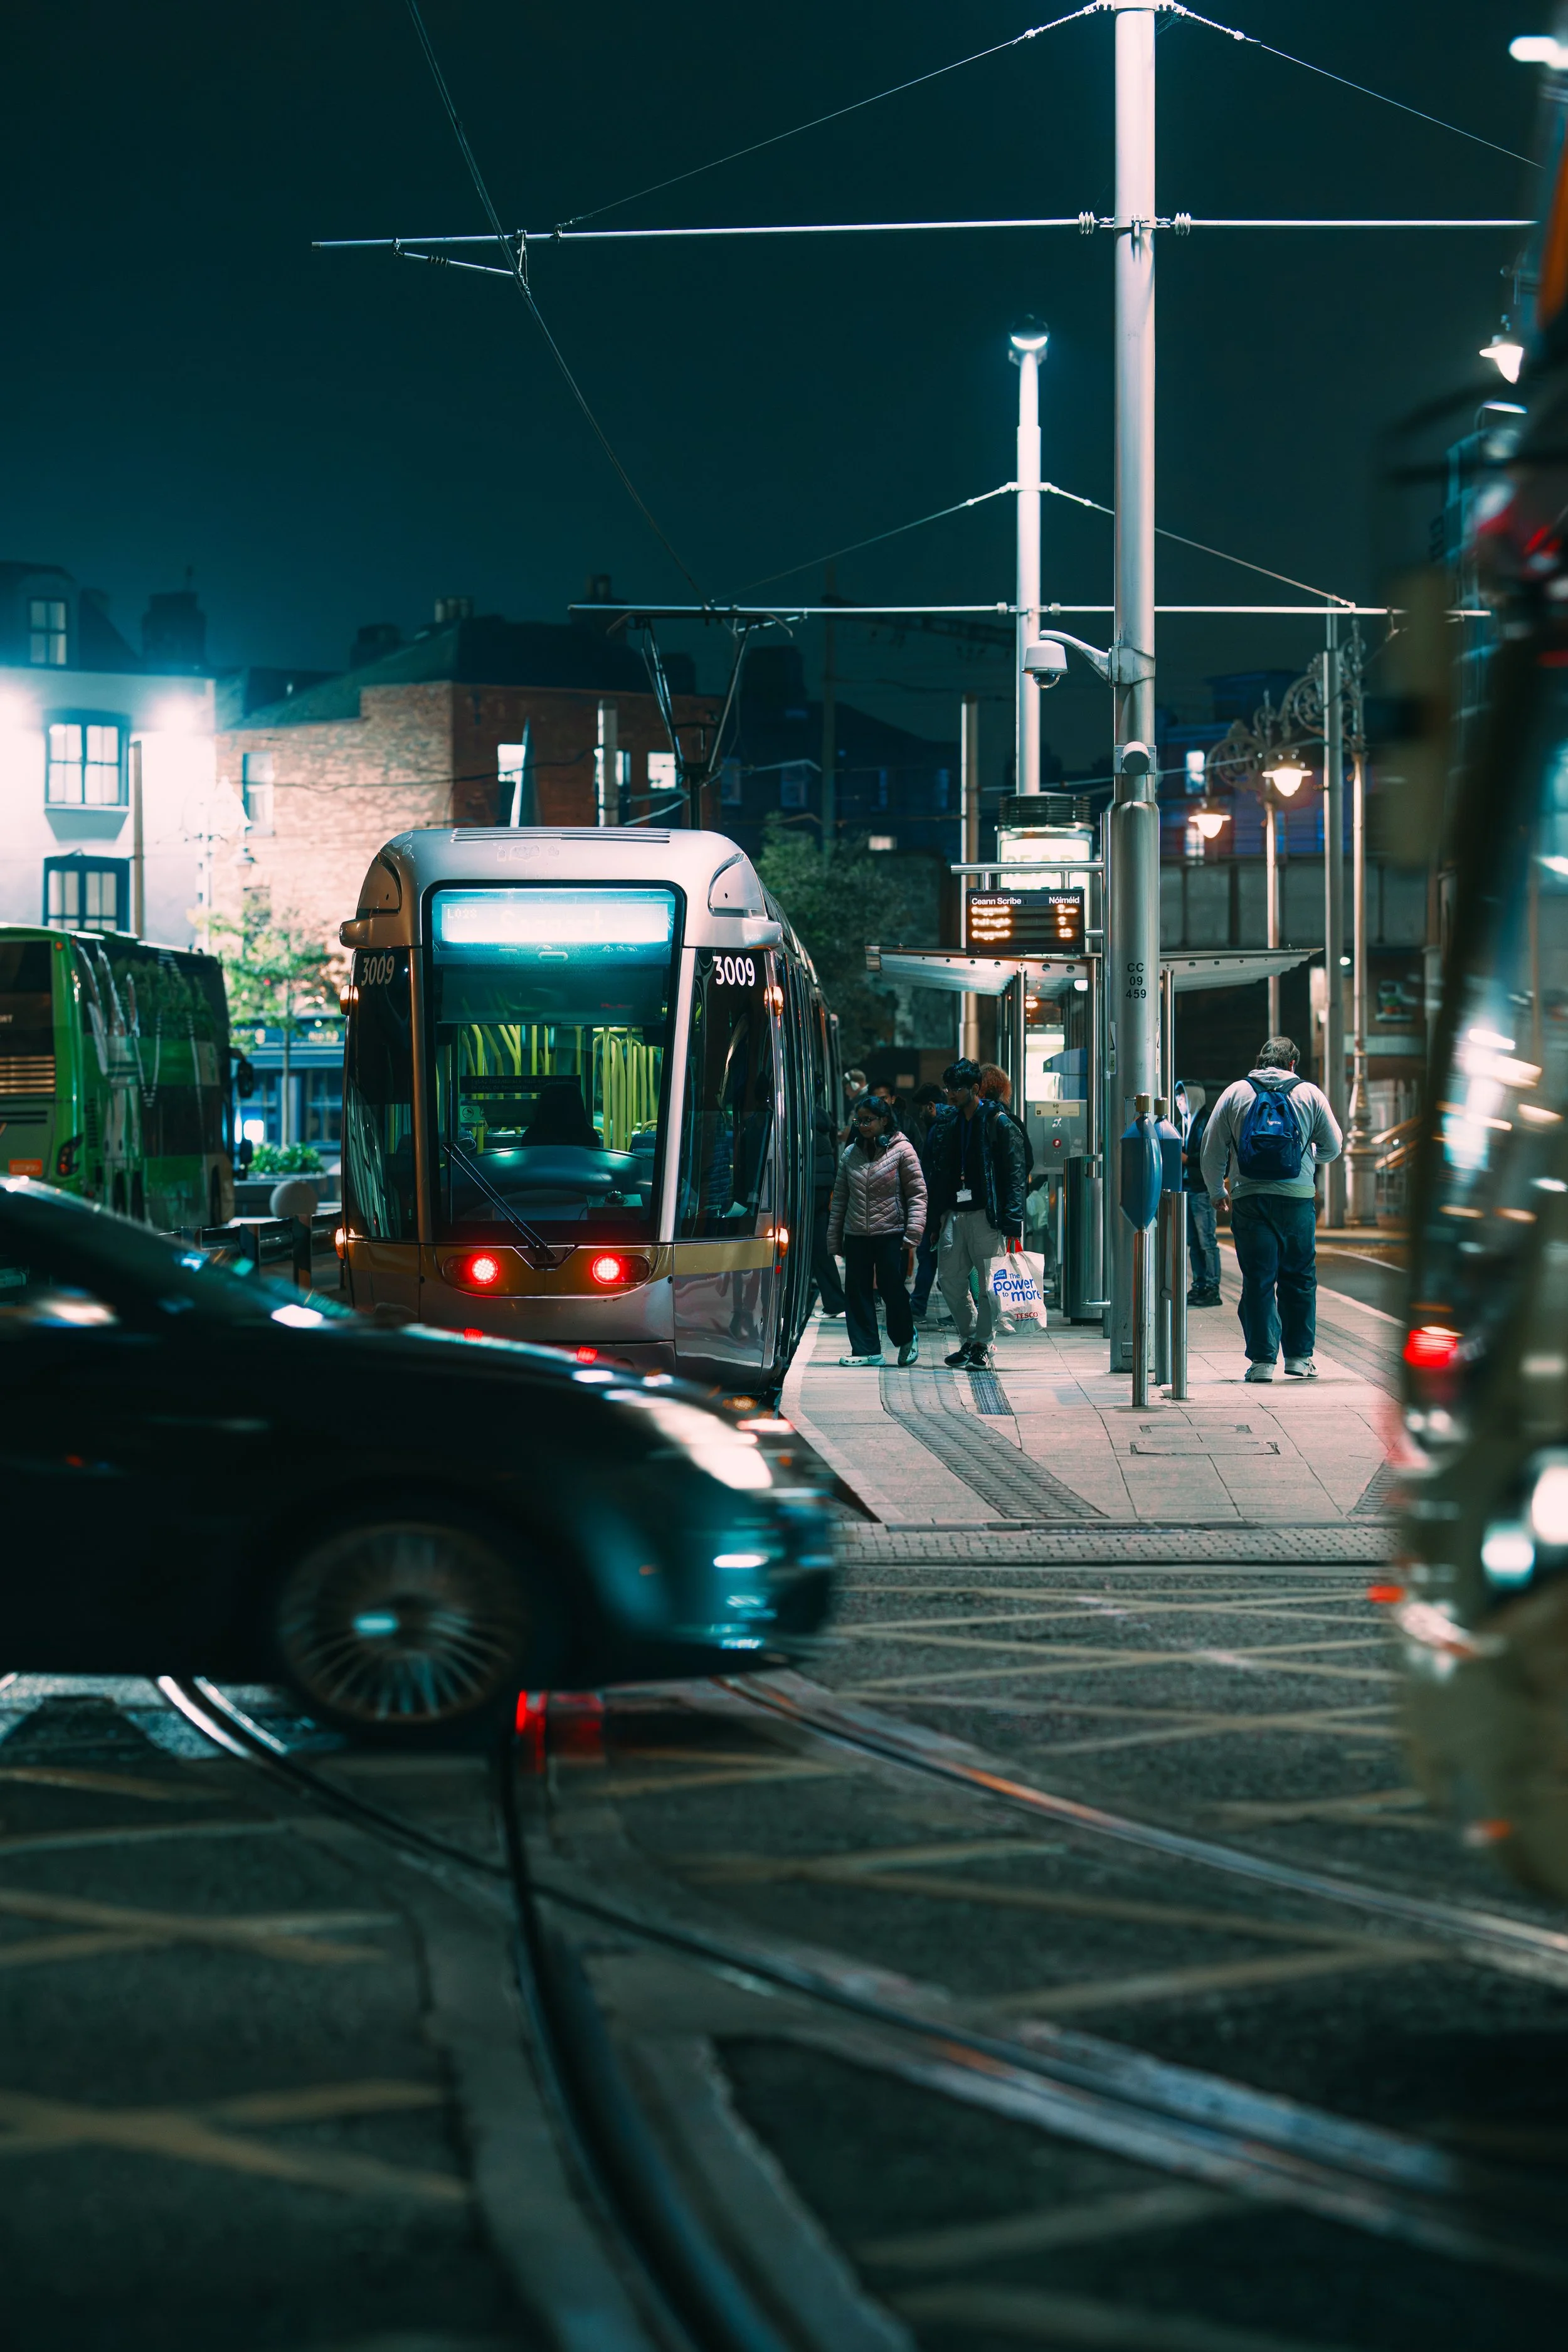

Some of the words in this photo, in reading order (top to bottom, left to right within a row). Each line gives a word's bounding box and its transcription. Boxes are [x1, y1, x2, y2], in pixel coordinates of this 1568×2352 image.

[997, 897, 1022, 905] Scríbe
[1049, 896, 1080, 904] Nóiméid
[361, 955, 395, 987] 3009
[712, 956, 755, 987] 3009
[1127, 963, 1144, 973] CC
[1130, 976, 1143, 986] 09
[1126, 989, 1147, 999] 459
[993, 1278, 1034, 1296] power
[1010, 1290, 1042, 1301] more
